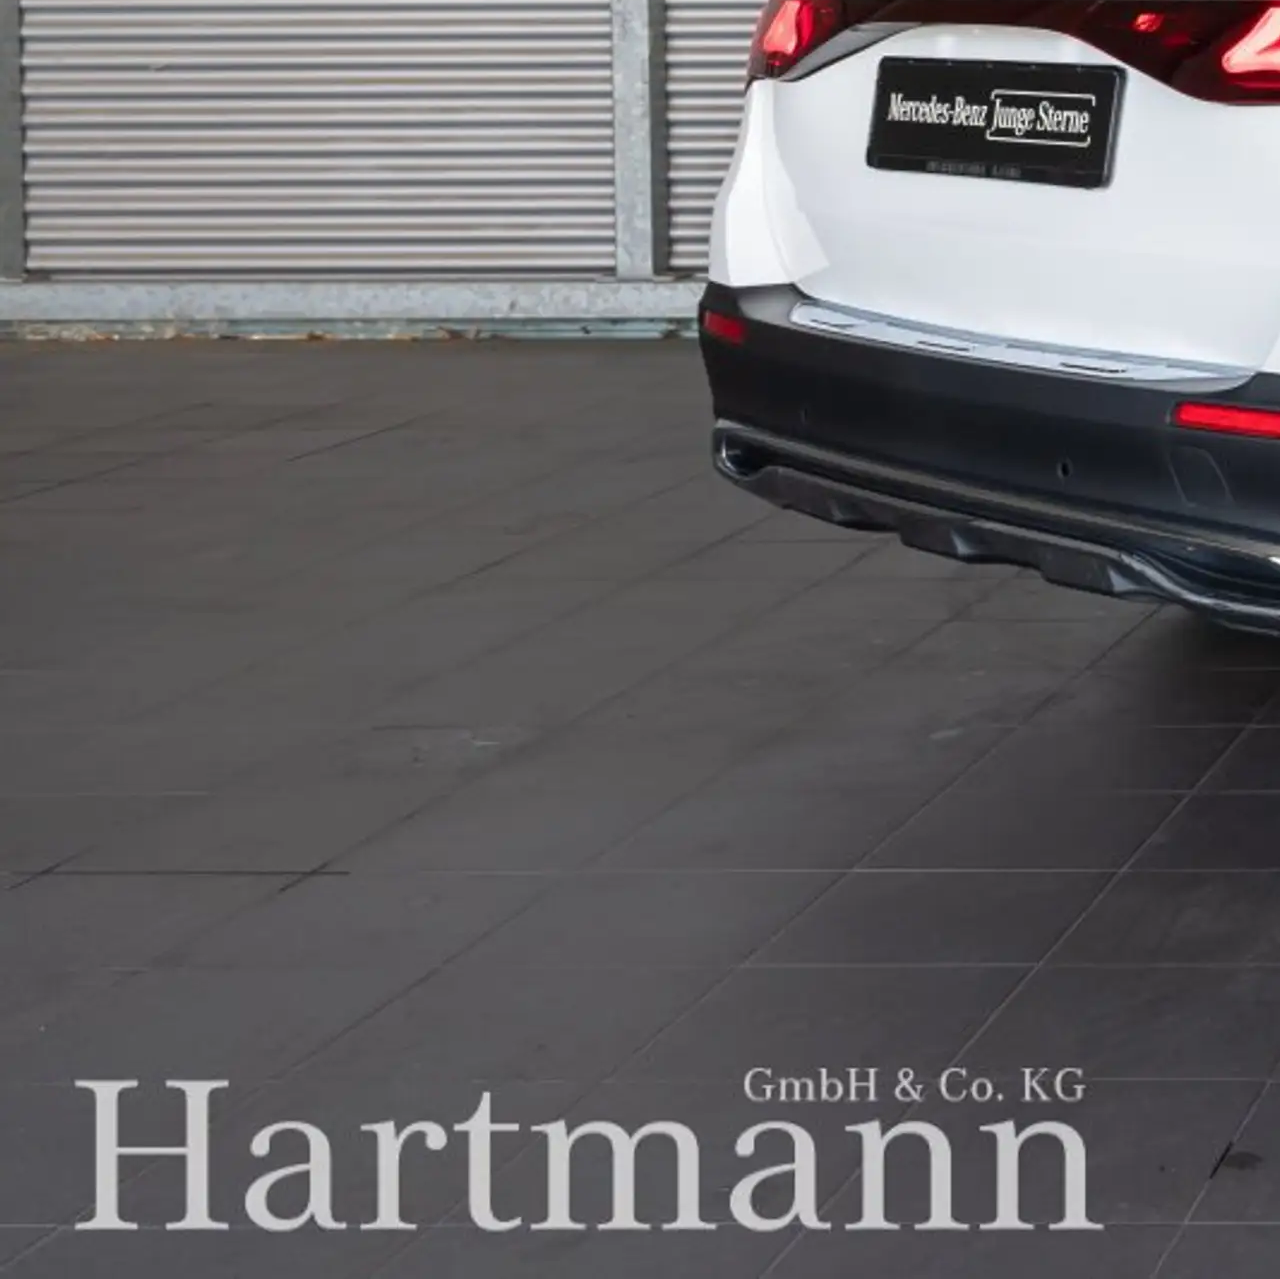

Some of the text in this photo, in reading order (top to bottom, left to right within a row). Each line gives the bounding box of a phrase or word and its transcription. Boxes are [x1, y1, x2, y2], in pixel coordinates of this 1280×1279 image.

[887, 92, 1090, 136] Mercedes-Benz Junge Sterne
